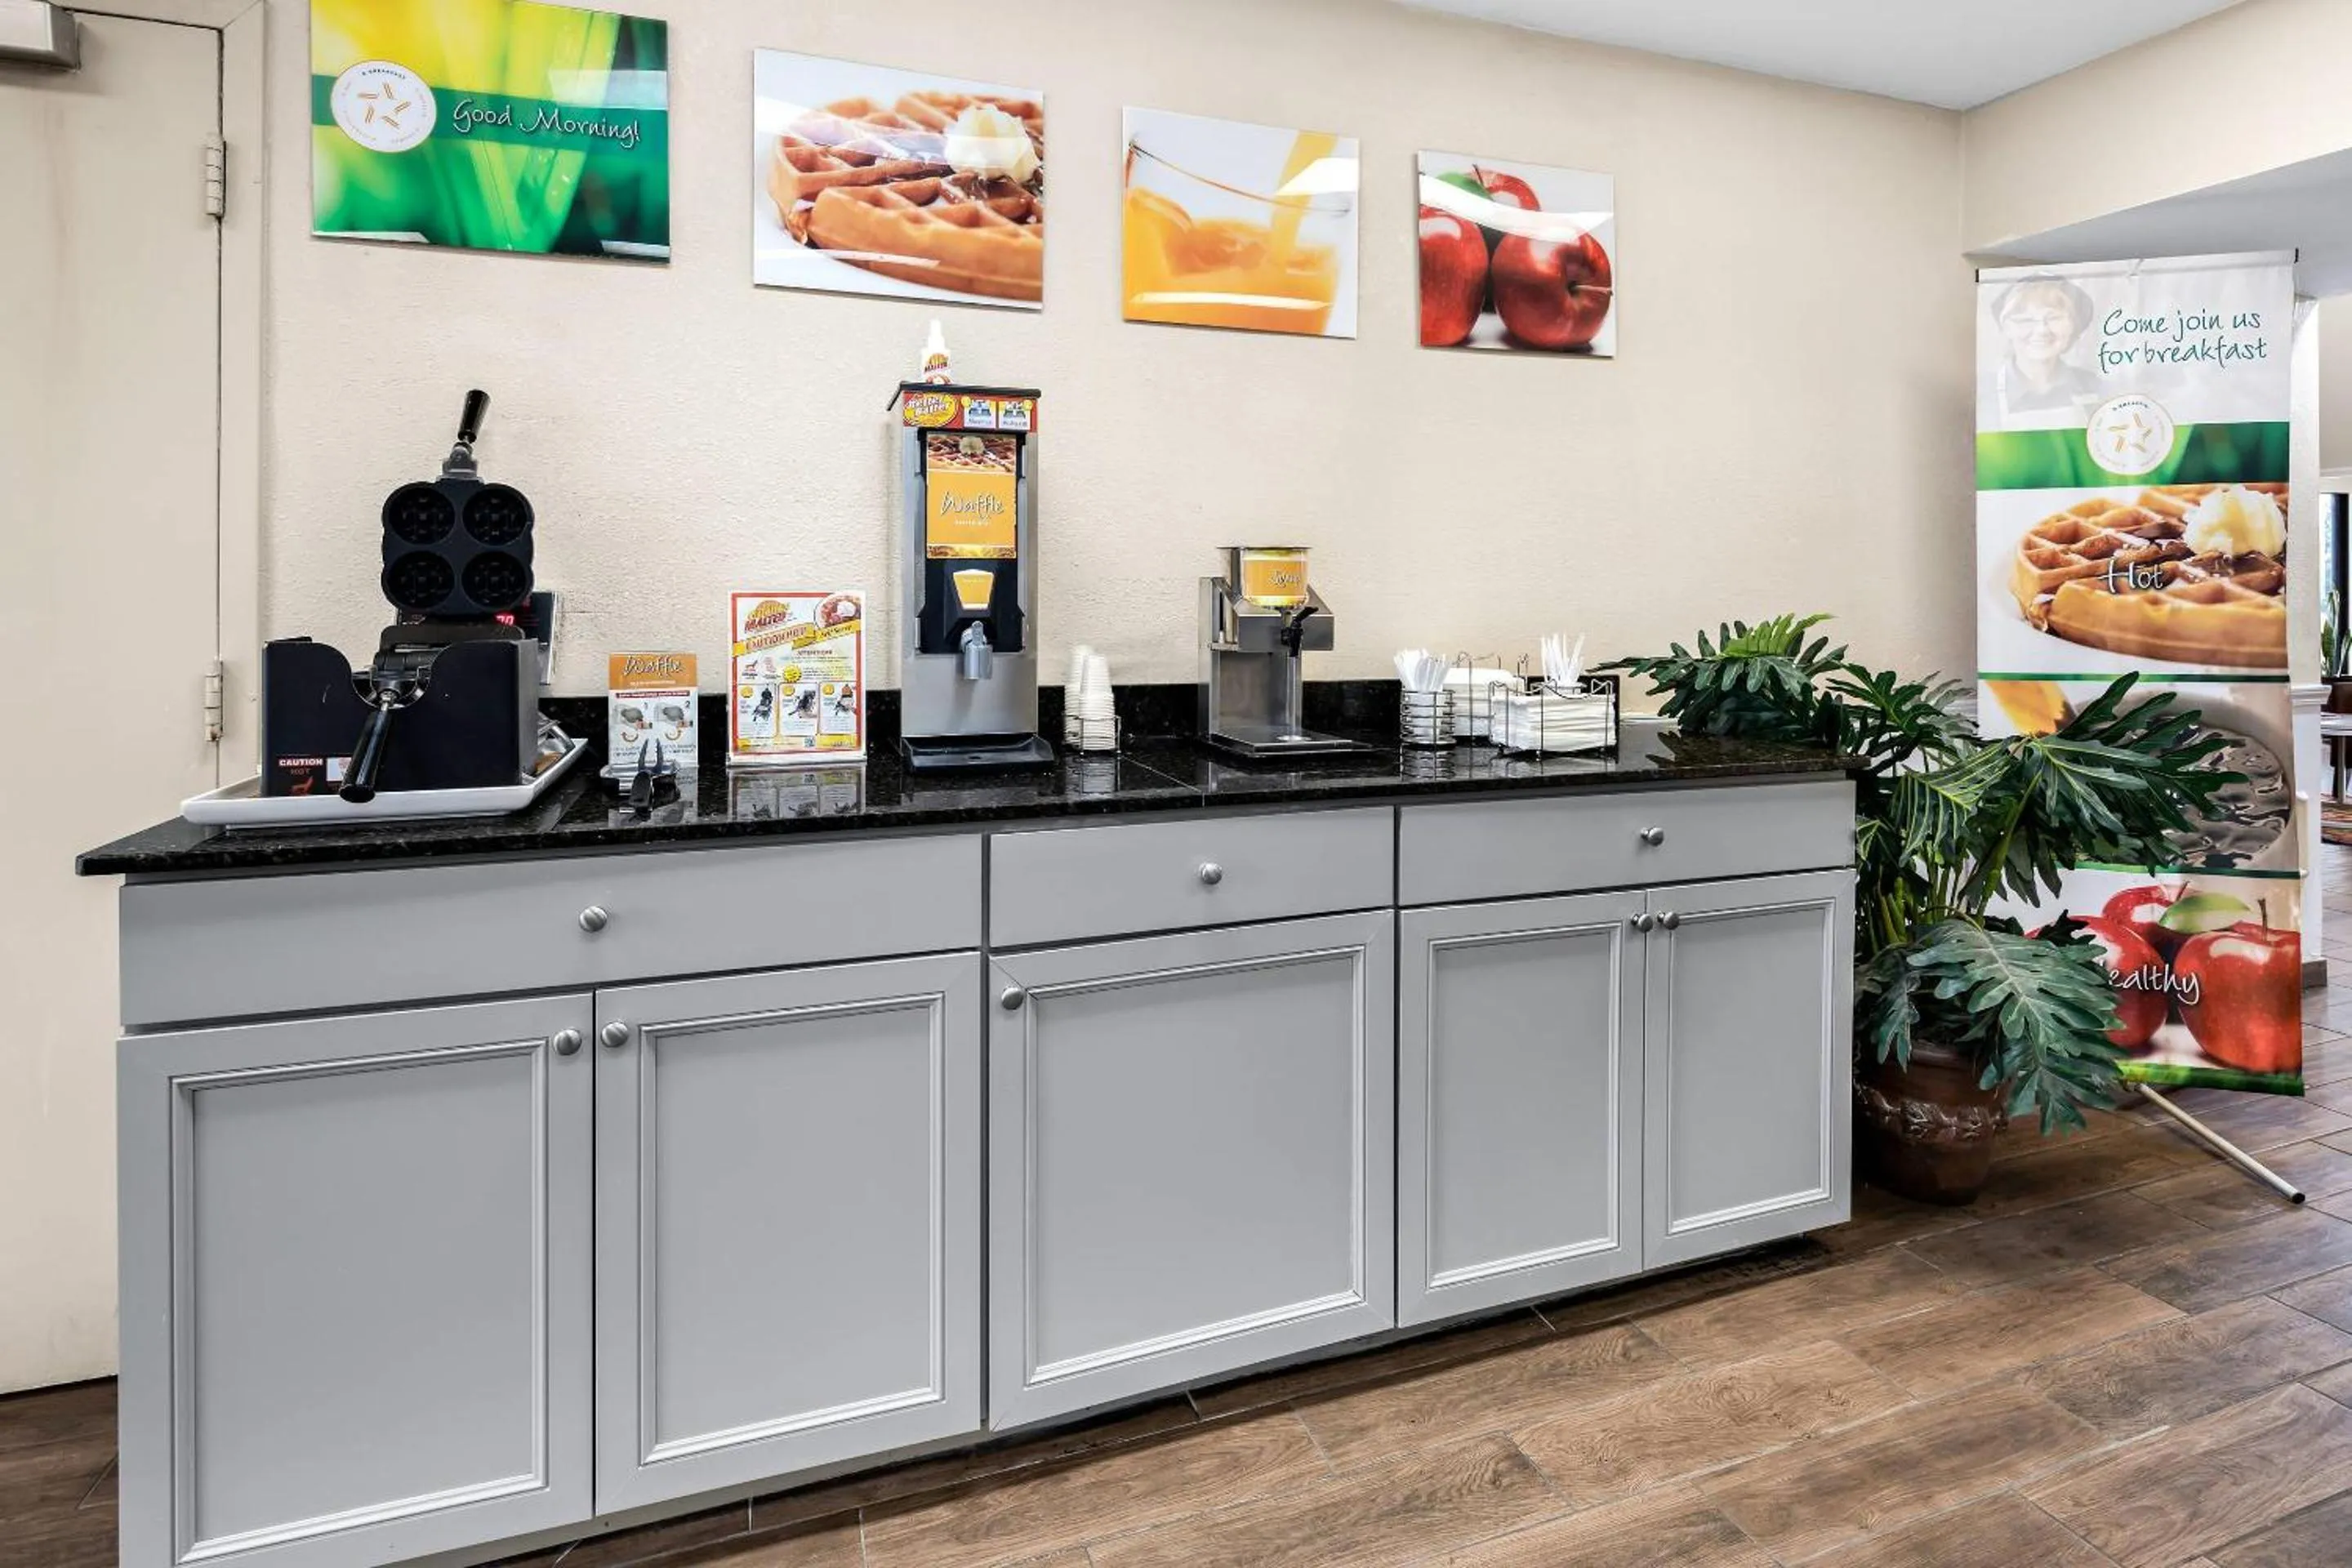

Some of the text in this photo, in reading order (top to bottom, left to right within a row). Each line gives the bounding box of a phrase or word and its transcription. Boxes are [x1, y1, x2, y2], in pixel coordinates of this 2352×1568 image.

[453, 99, 513, 133] Good
[518, 109, 641, 149] Morning!
[2103, 308, 2261, 343] Come join us
[2097, 335, 2268, 374] for breakfast
[941, 492, 1004, 520] Waffle
[2097, 559, 2164, 595] Hot
[278, 758, 323, 767] CAUTION
[2100, 964, 2201, 1005] ealthy
